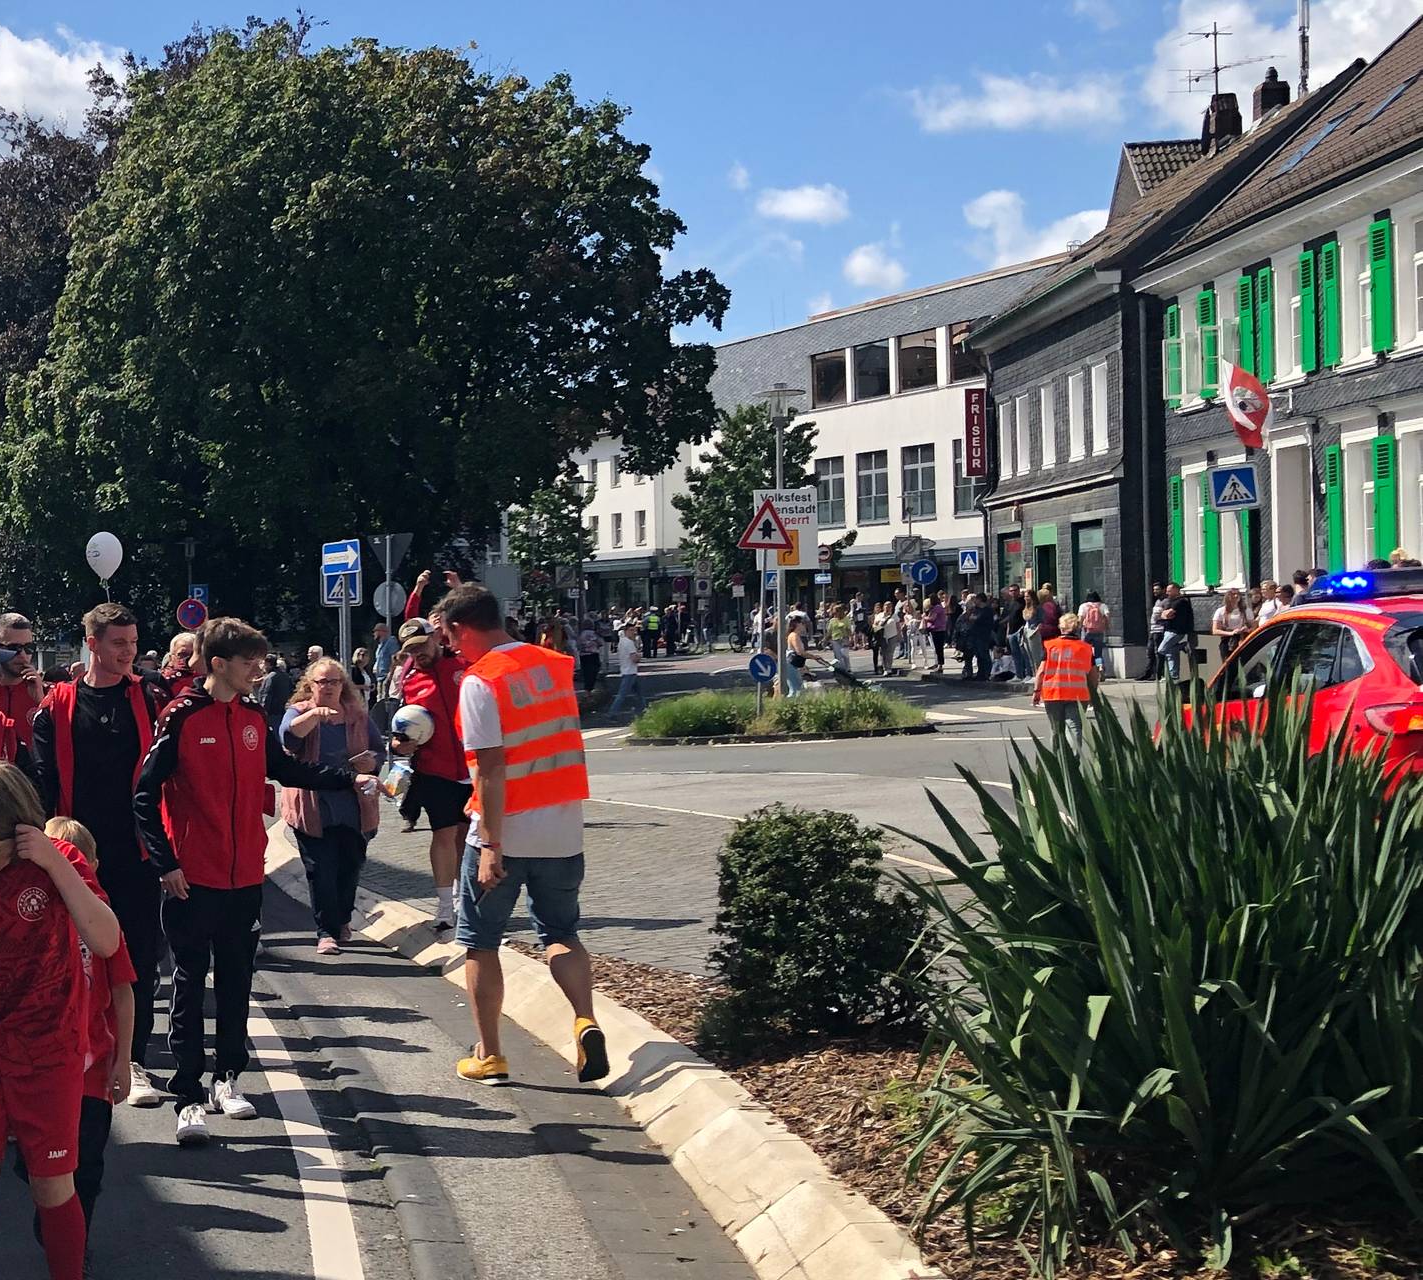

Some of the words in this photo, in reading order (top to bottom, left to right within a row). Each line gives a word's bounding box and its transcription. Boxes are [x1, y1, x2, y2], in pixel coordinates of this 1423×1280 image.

[971, 393, 982, 468] FRISEUR
[760, 492, 812, 503] Volksfest
[757, 505, 817, 515] enstadt
[193, 587, 205, 601] P
[200, 737, 217, 745] JAKO
